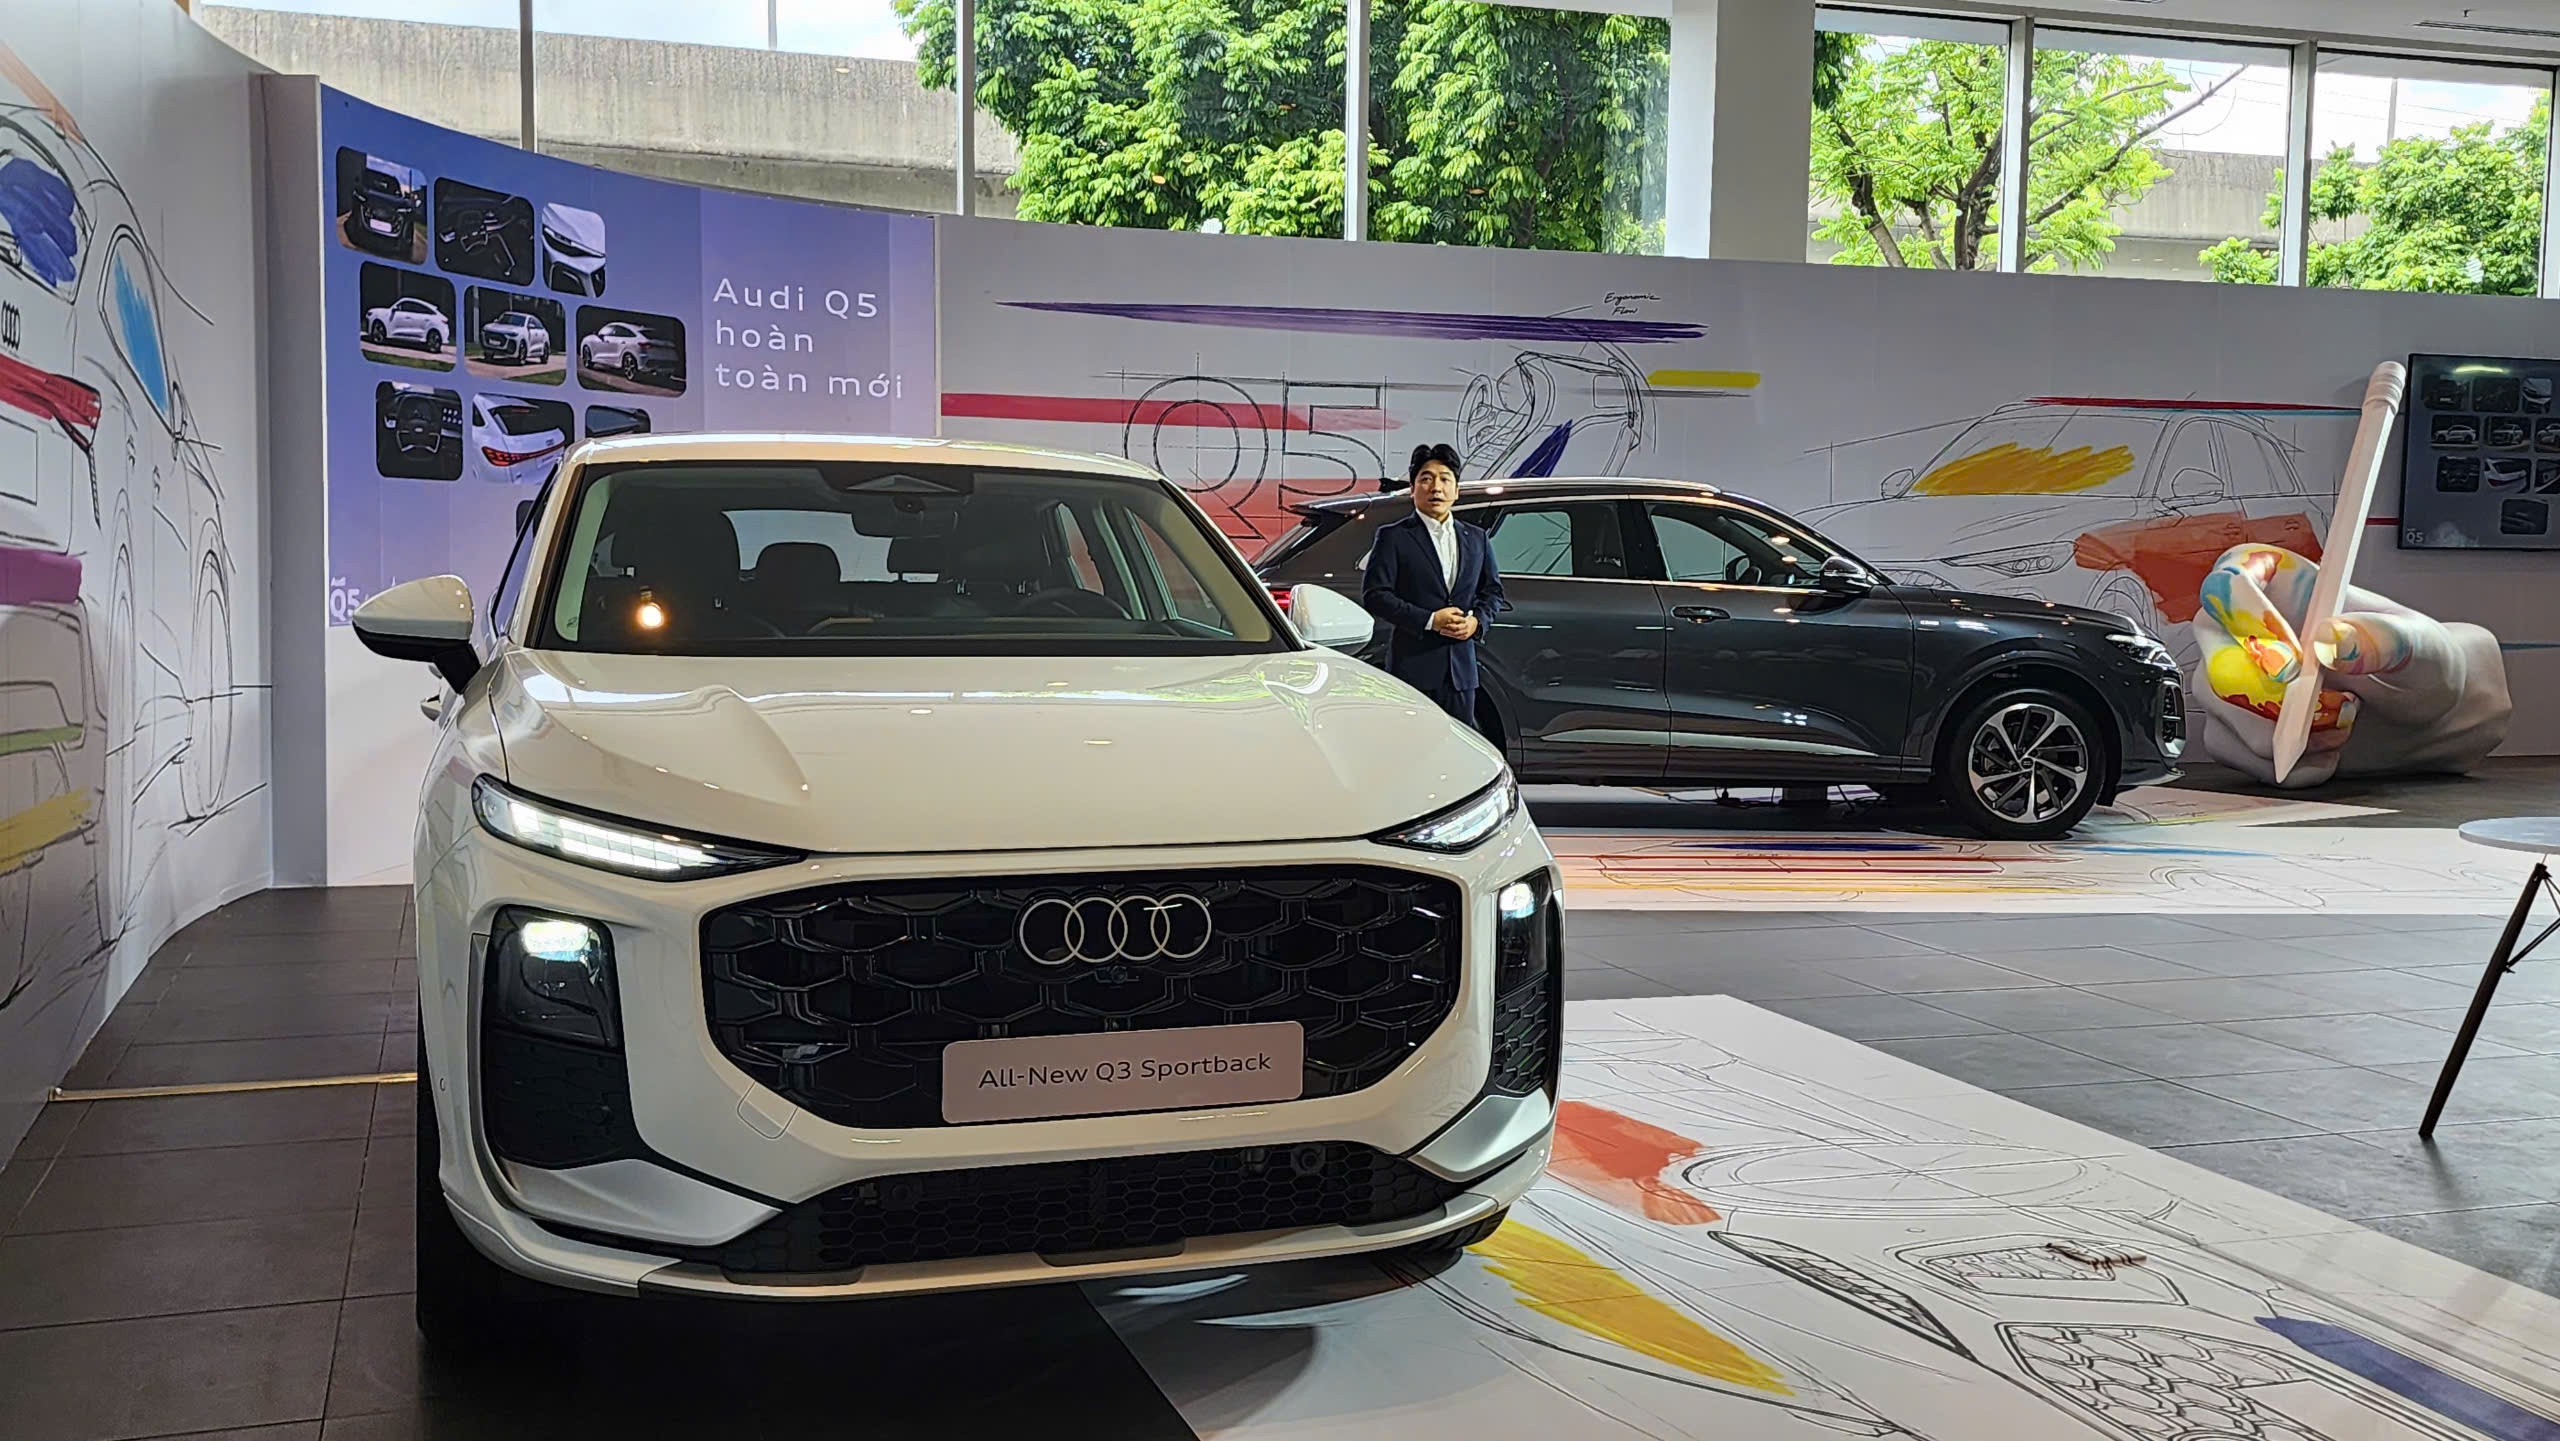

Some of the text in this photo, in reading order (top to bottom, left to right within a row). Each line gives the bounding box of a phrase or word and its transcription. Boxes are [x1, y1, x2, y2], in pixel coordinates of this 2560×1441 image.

[713, 278, 877, 319] Audi Q5
[1611, 306, 1638, 316] Flow
[716, 319, 813, 352] hoàn
[715, 363, 902, 399] toàn mới
[1124, 375, 1385, 539] Q5
[330, 588, 361, 622] Q5
[978, 1052, 1272, 1089] All-New Q3 Sportback
